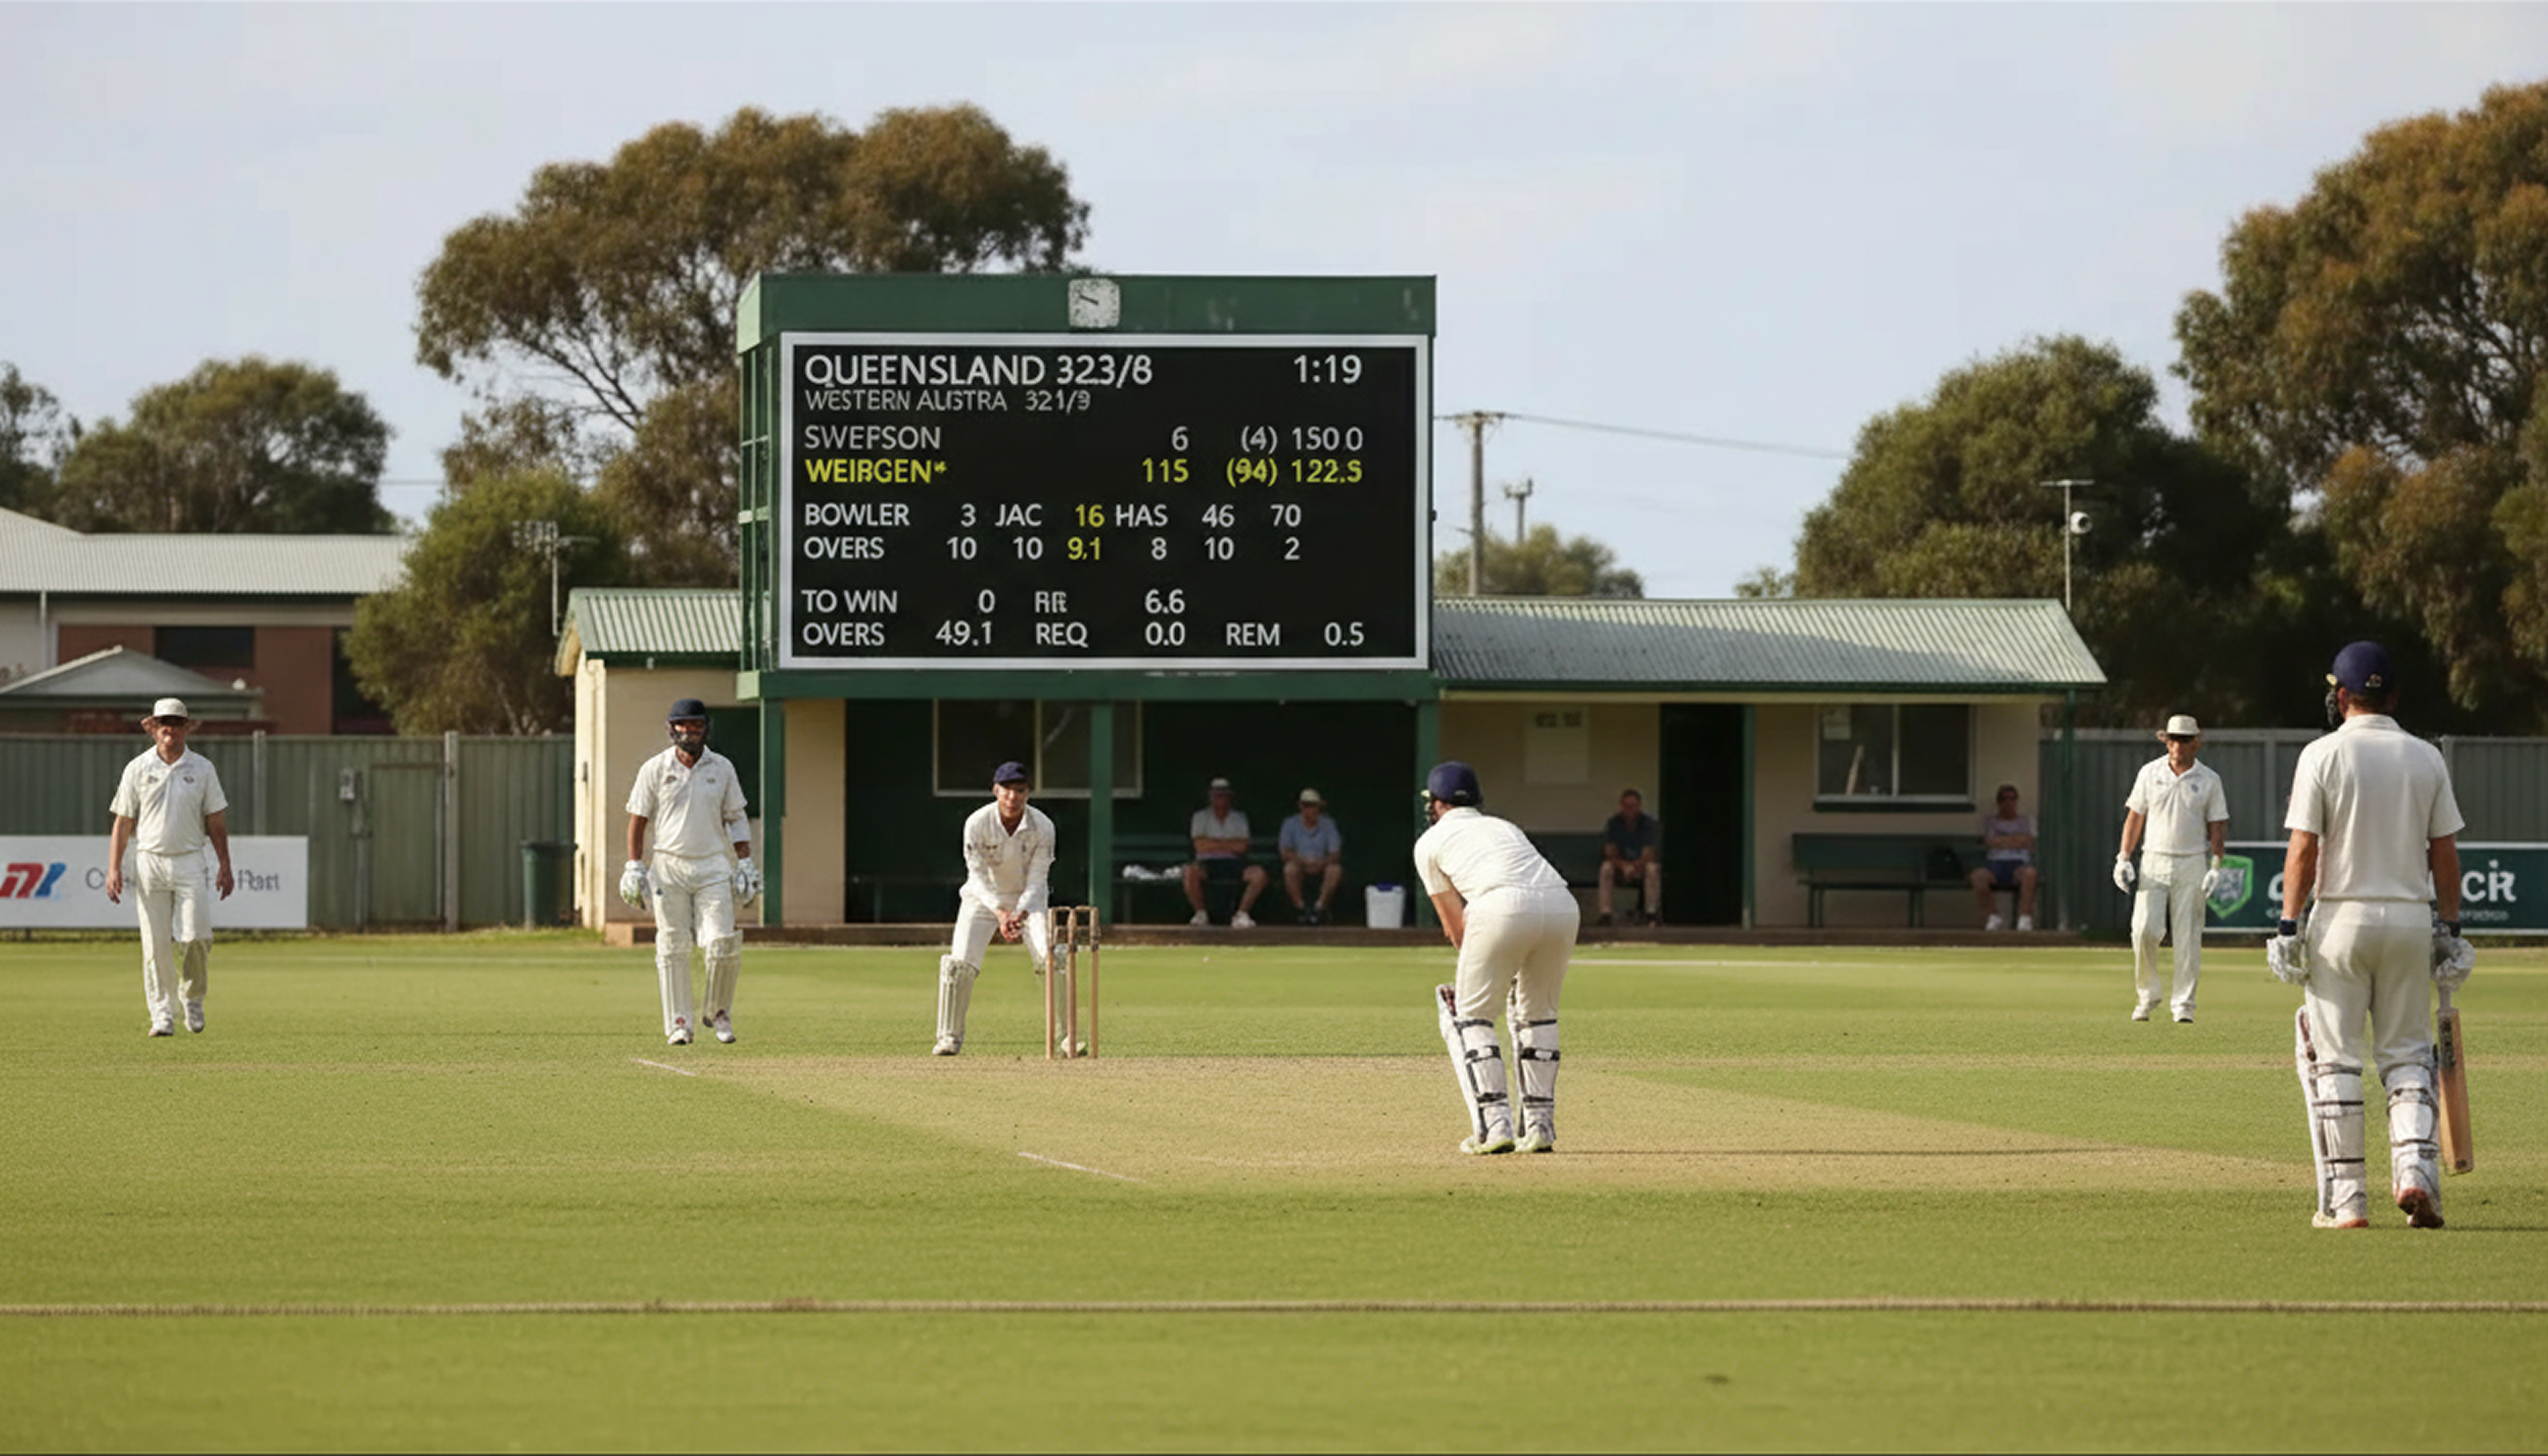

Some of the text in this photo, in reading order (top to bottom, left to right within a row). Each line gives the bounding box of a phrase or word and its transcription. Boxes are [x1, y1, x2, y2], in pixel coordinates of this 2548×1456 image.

[805, 354, 1361, 389] QUEENSLAND 323/8 1:19
[805, 390, 909, 410] WESTERN
[1173, 426, 1188, 450] 6
[1241, 426, 1277, 454] (4)
[1143, 458, 1188, 482] 115
[1227, 458, 1277, 487] (94)
[805, 503, 1301, 527] BOWLER 3 JAC 16 HAS 46 70
[804, 537, 1299, 560] OVERS 10 10 9.1 8 10 2
[801, 589, 837, 612] TO
[844, 590, 897, 612] WIN
[979, 589, 995, 613] 0
[1146, 589, 1185, 613] 6.6
[803, 620, 1364, 648] OVERS 49.1 REQ 0.0 REM 0.5
